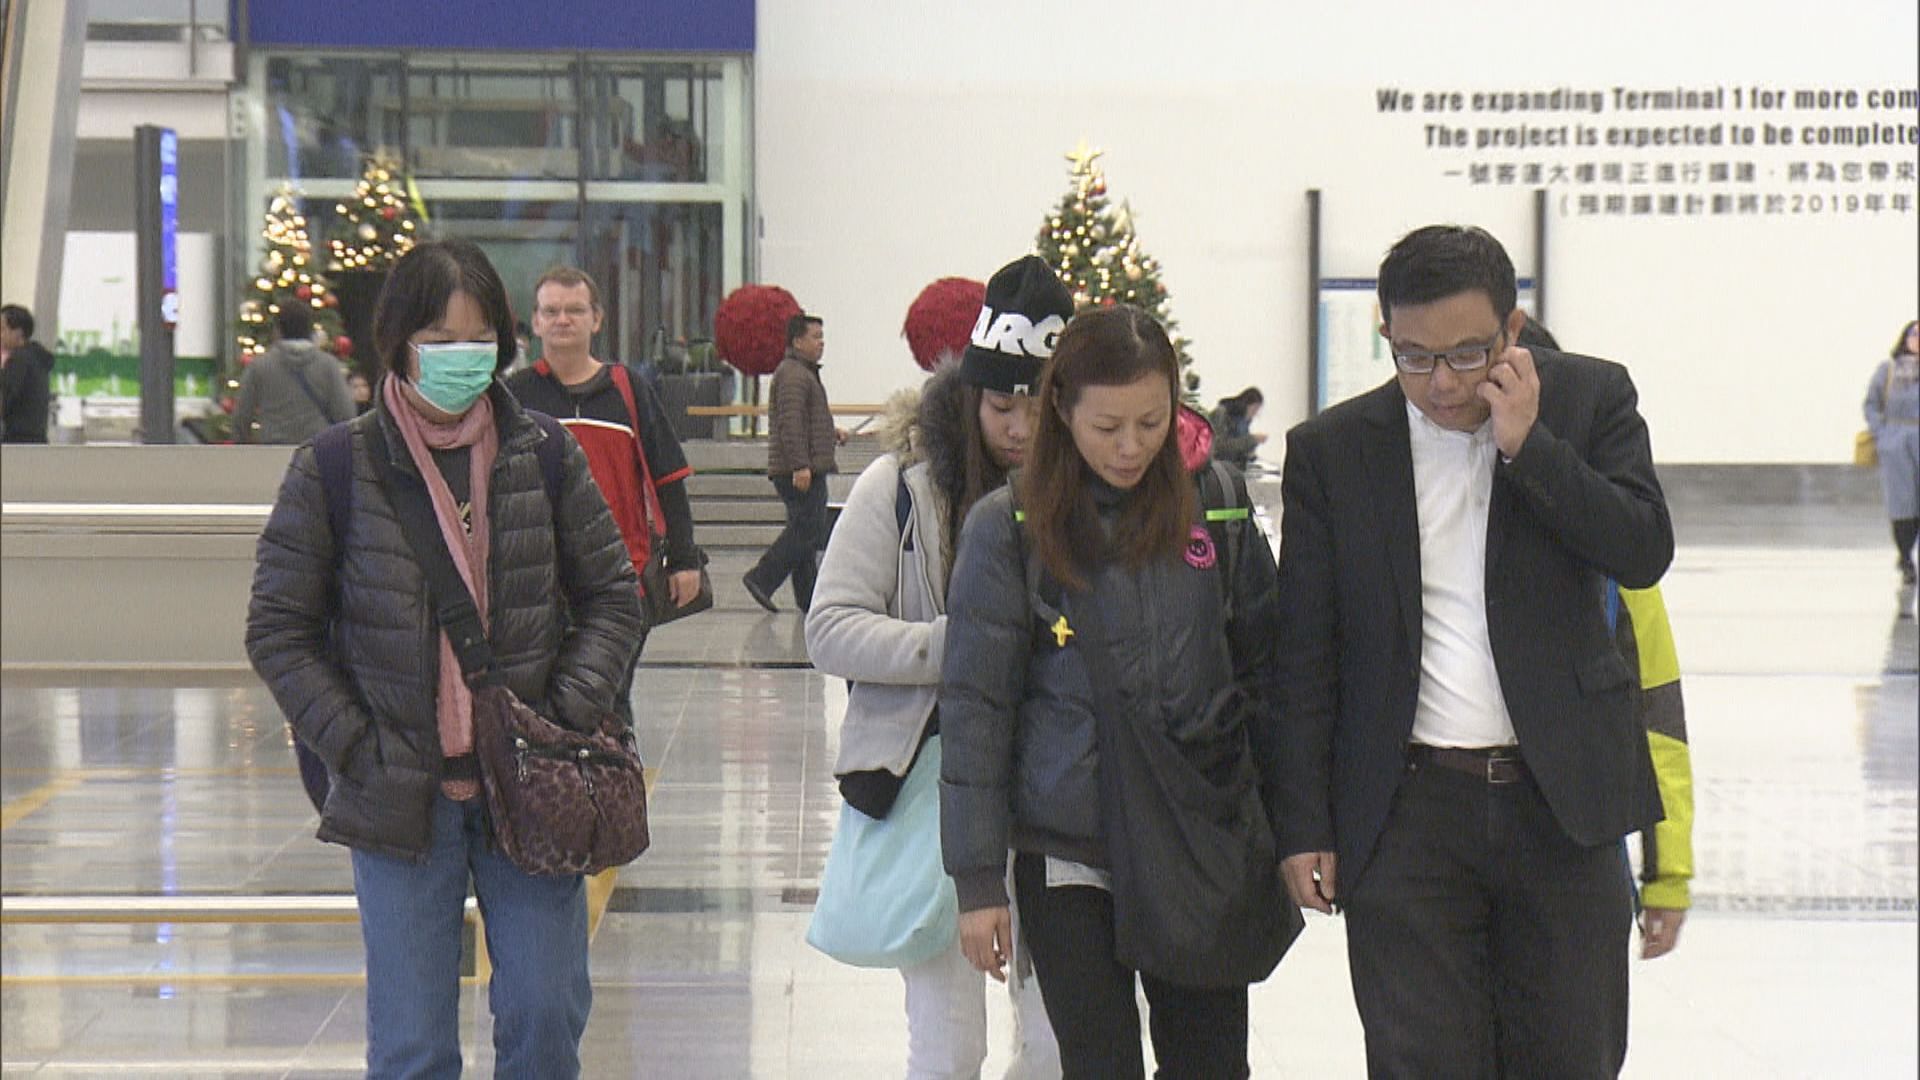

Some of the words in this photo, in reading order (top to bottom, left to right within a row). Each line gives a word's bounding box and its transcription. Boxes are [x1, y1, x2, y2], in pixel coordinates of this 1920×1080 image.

[1376, 89, 1415, 113] We
[1422, 92, 1464, 112] are
[1471, 88, 1604, 114] expanding
[1612, 87, 1724, 111] Terminal
[1733, 88, 1743, 110] 1
[1750, 87, 1786, 110] for
[1794, 89, 1859, 110] more
[1866, 89, 1918, 110] com
[1424, 124, 1468, 148] The
[1476, 124, 1568, 150] project
[1575, 124, 1598, 147] is
[1605, 123, 1723, 149] expected
[1730, 124, 1755, 146] to
[1763, 122, 1793, 146] be
[1801, 121, 1918, 149] complete
